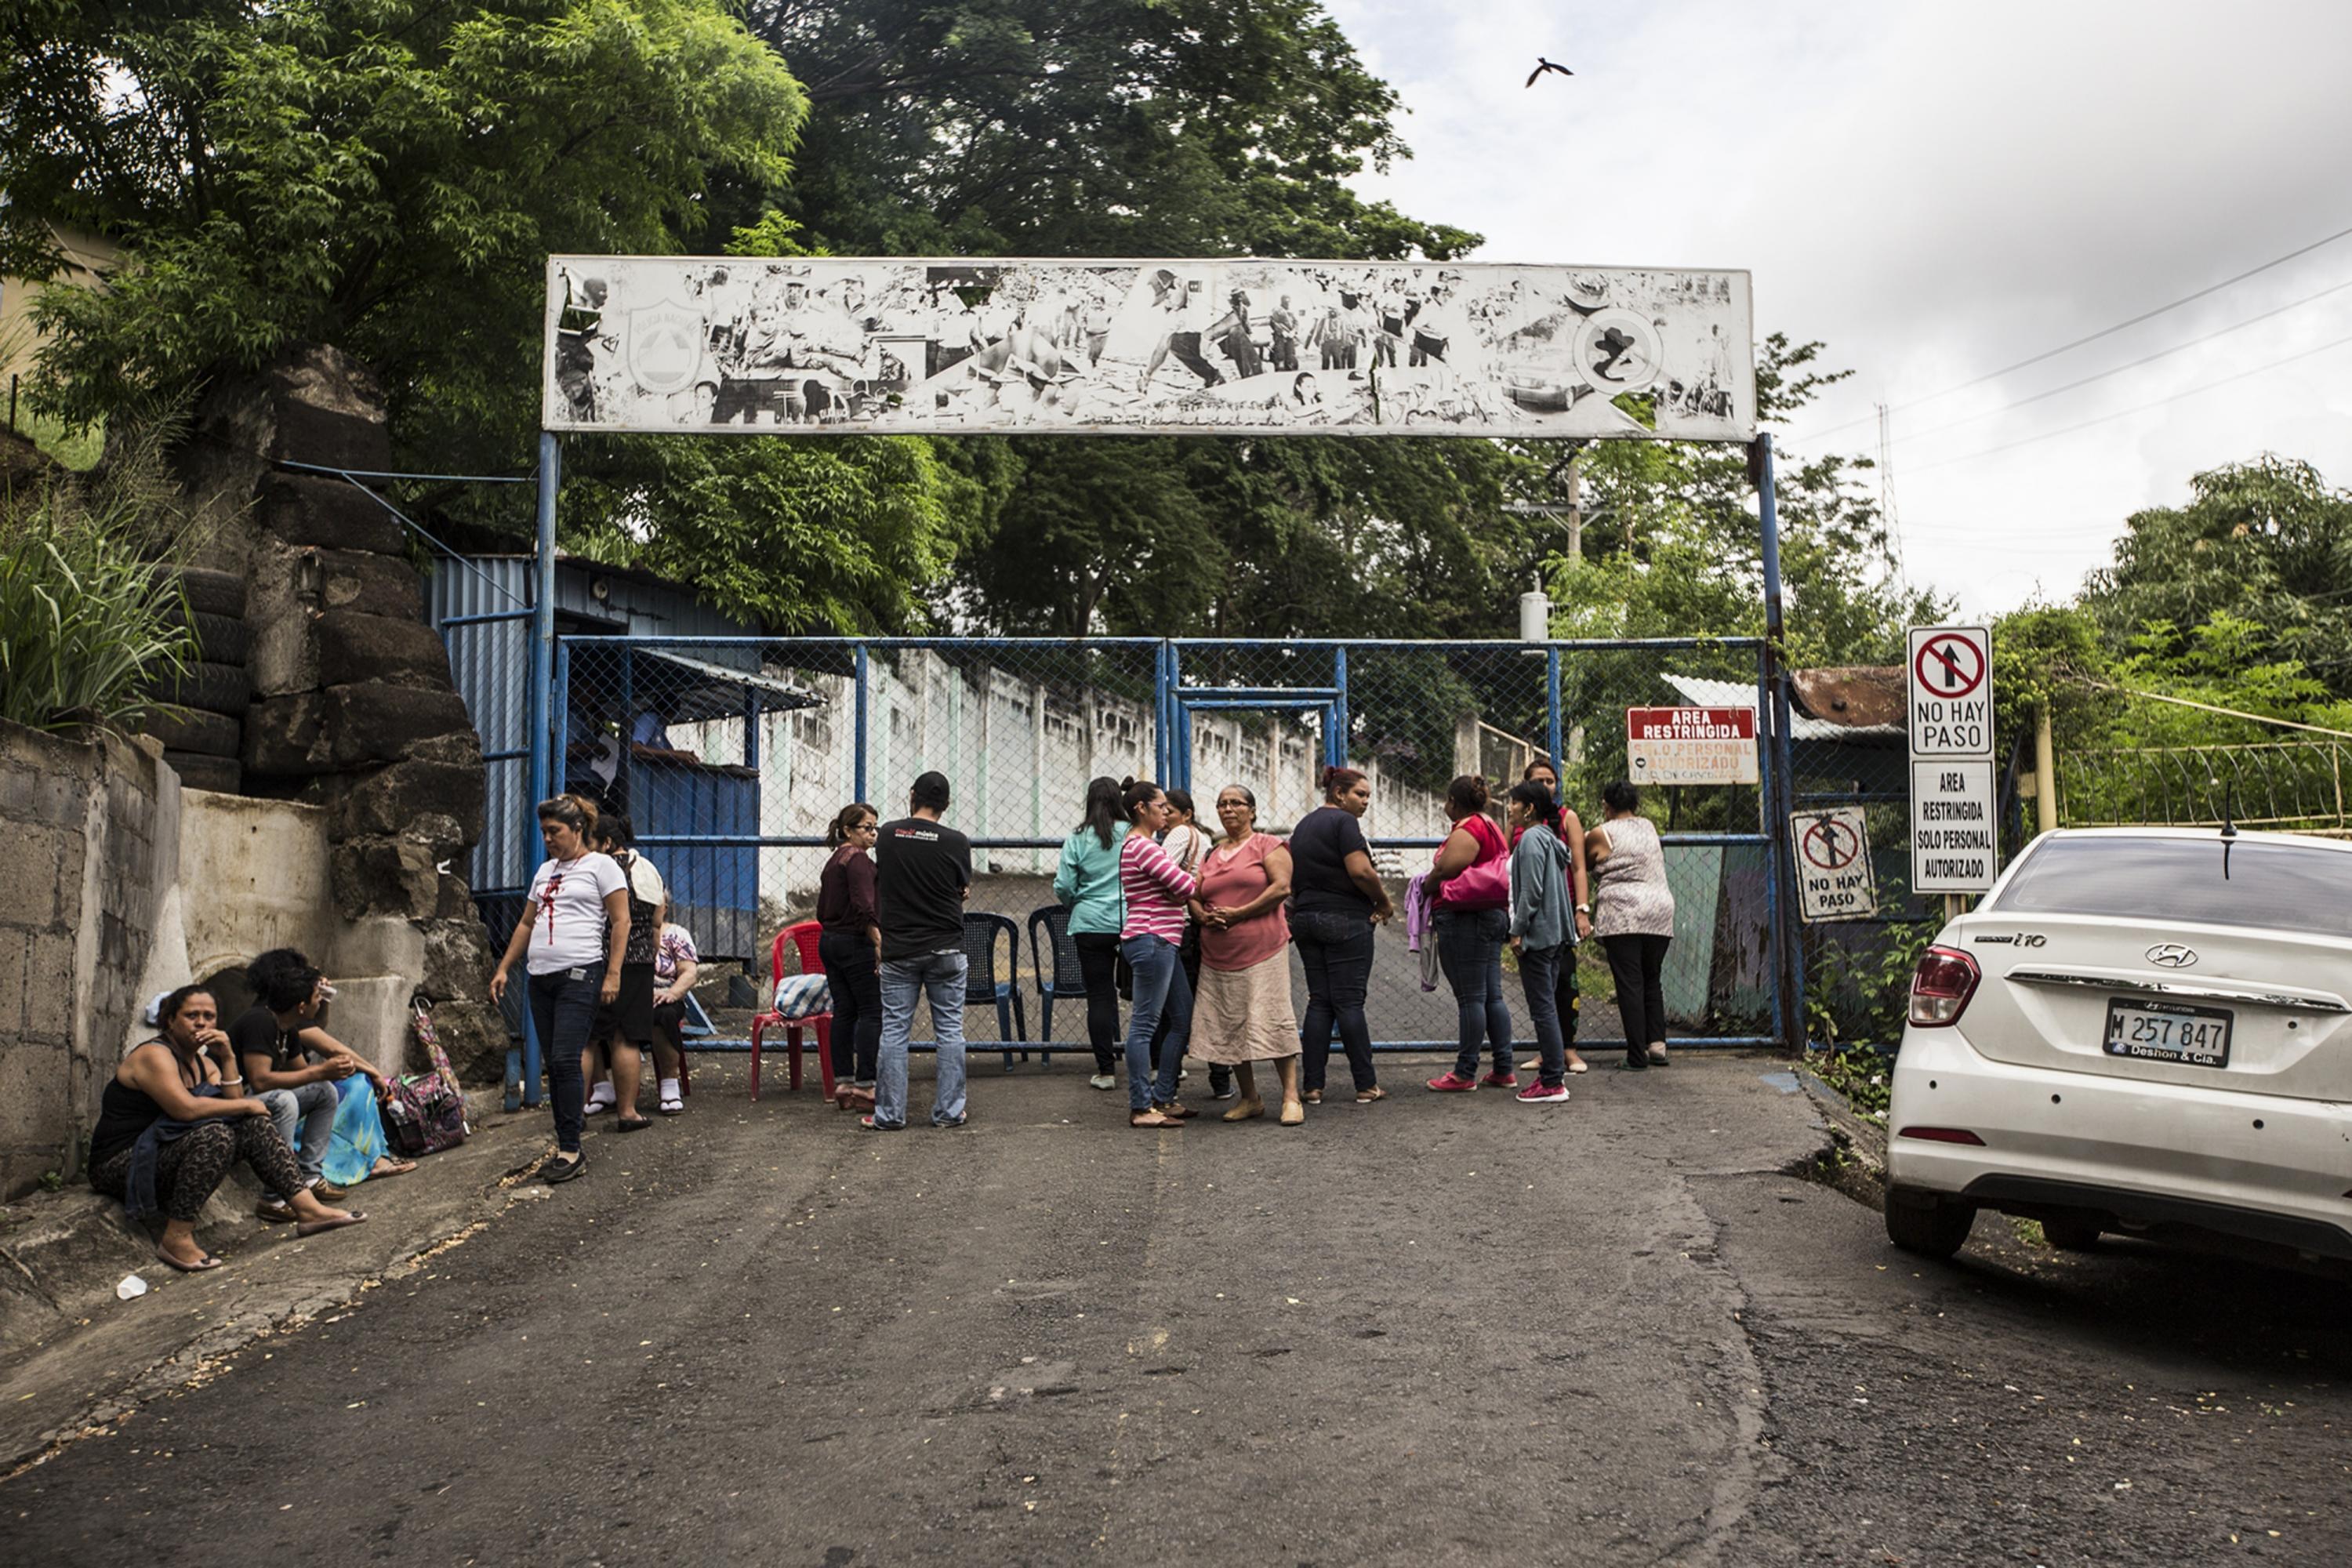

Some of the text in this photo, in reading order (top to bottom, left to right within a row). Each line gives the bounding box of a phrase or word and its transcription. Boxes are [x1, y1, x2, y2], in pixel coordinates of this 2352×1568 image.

[1672, 711, 1711, 724] AREA
[1918, 702, 1984, 722] NO HAY
[1644, 725, 1740, 738] RESTRINGIDA
[1925, 725, 1980, 747] PASO
[1677, 742, 1751, 754] PERSONAL
[1649, 757, 1739, 769] AUTORIZADO
[1940, 772, 1965, 792] AREA
[1923, 802, 1983, 820] RESTRINGIDA
[1918, 830, 1991, 849] SOLO PERSONAL
[1925, 859, 1984, 878] AUTORIZADO
[1809, 874, 1863, 891] NO HAY
[1820, 891, 1854, 907] PASO
[2111, 1014, 2223, 1049] M 257 847
[2132, 1045, 2216, 1065] Deshon & Cia.
